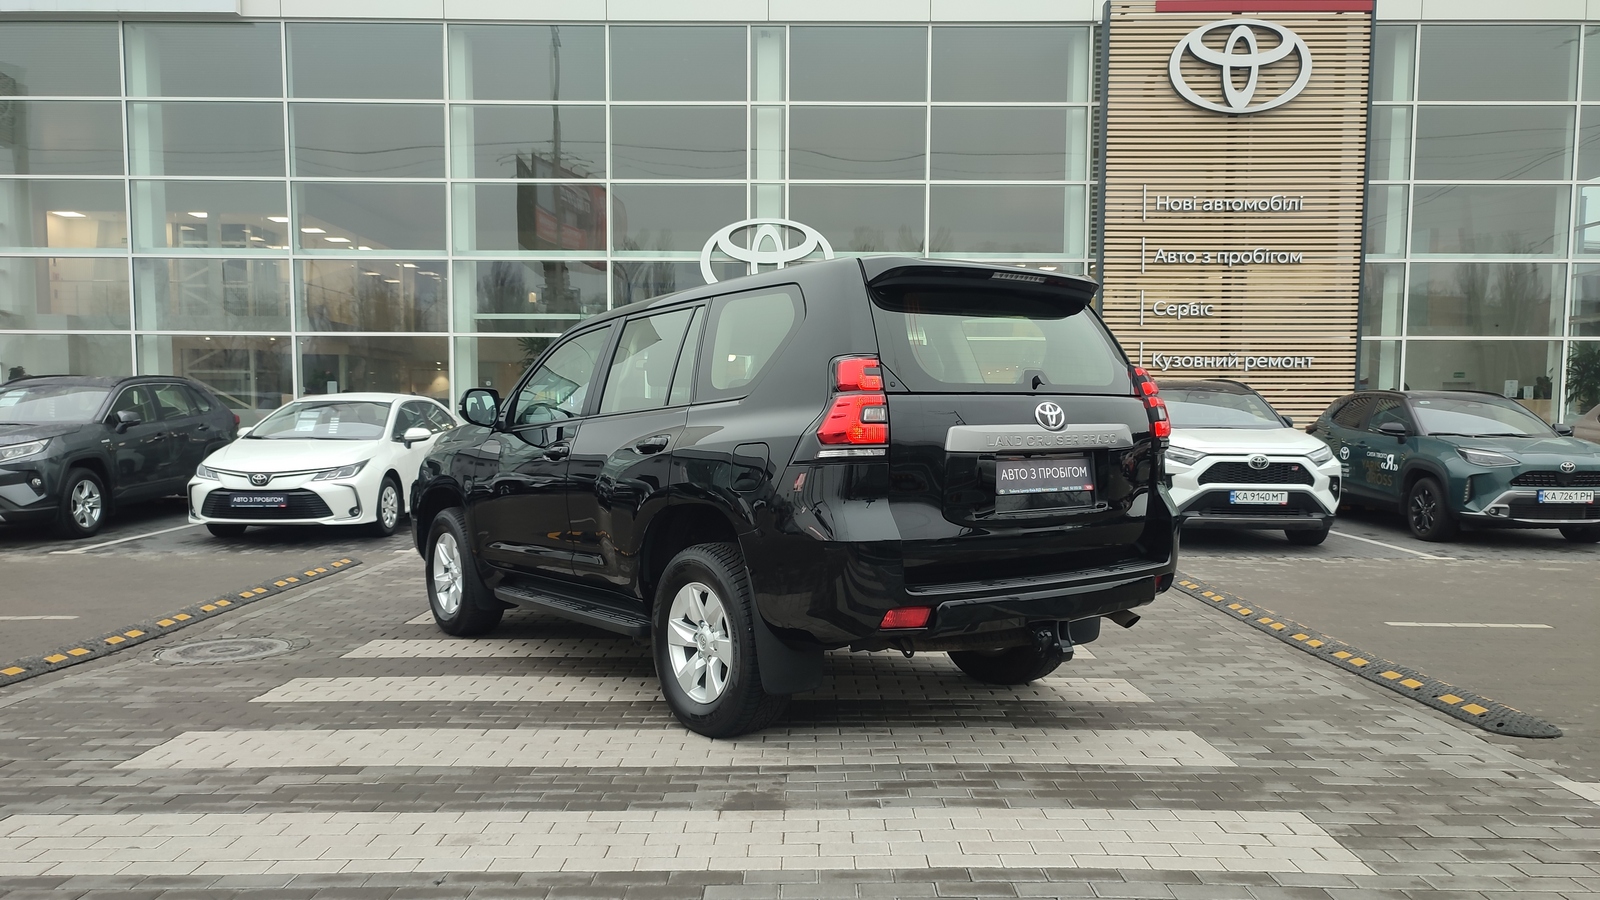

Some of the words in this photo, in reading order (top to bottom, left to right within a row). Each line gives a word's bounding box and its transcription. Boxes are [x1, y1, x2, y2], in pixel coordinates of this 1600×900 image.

[1155, 195, 1198, 211] Нові
[1202, 195, 1304, 211] автомобілі
[1153, 248, 1197, 264] Авто
[1201, 252, 1211, 264] з
[1216, 248, 1303, 268] пробігом
[1153, 300, 1215, 320] Сервіс
[1152, 352, 1239, 371] Кузовний
[1244, 355, 1314, 371] ремонт
[986, 435, 1022, 447] LAND
[1026, 434, 1079, 447] CRUISER
[1083, 433, 1117, 446] PRADO
[1001, 468, 1028, 481] АВТО
[1038, 466, 1088, 479] ПРОБІГОМ
[1250, 492, 1271, 501] 9140
[1559, 492, 1578, 501] 7261
